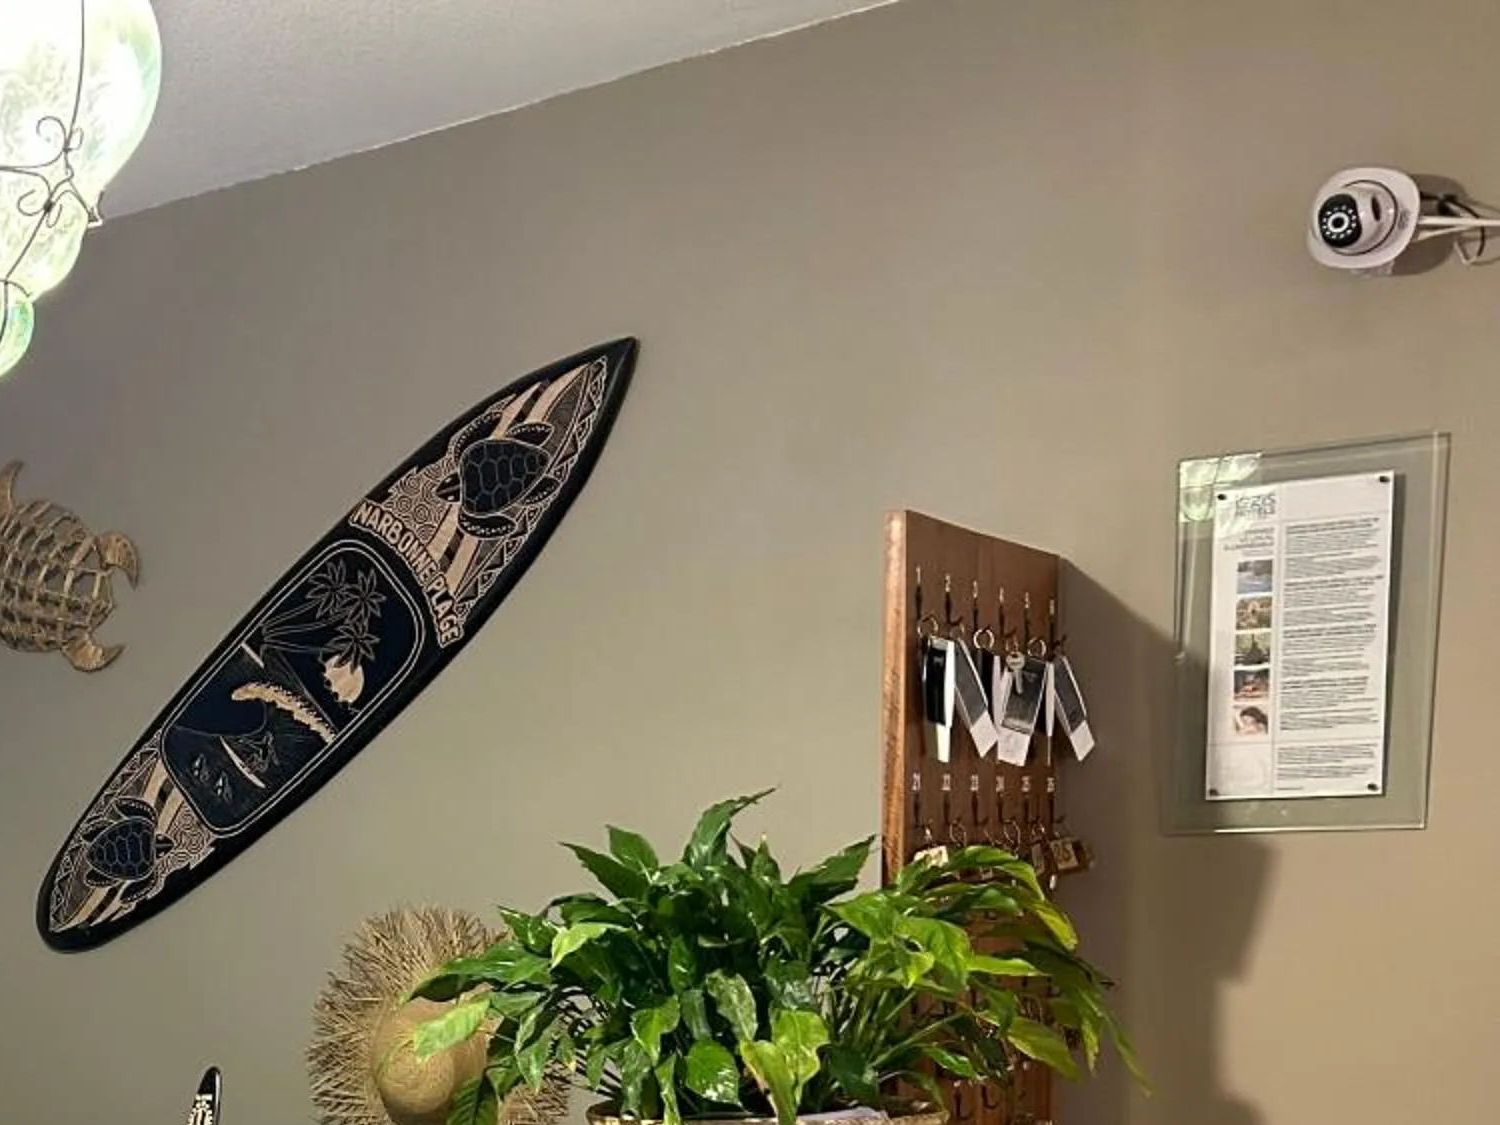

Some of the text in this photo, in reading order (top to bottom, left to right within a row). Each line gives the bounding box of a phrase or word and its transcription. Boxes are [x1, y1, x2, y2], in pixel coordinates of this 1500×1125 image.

[353, 502, 460, 643] NARBONNE PLAGE
[915, 566, 921, 584] 1
